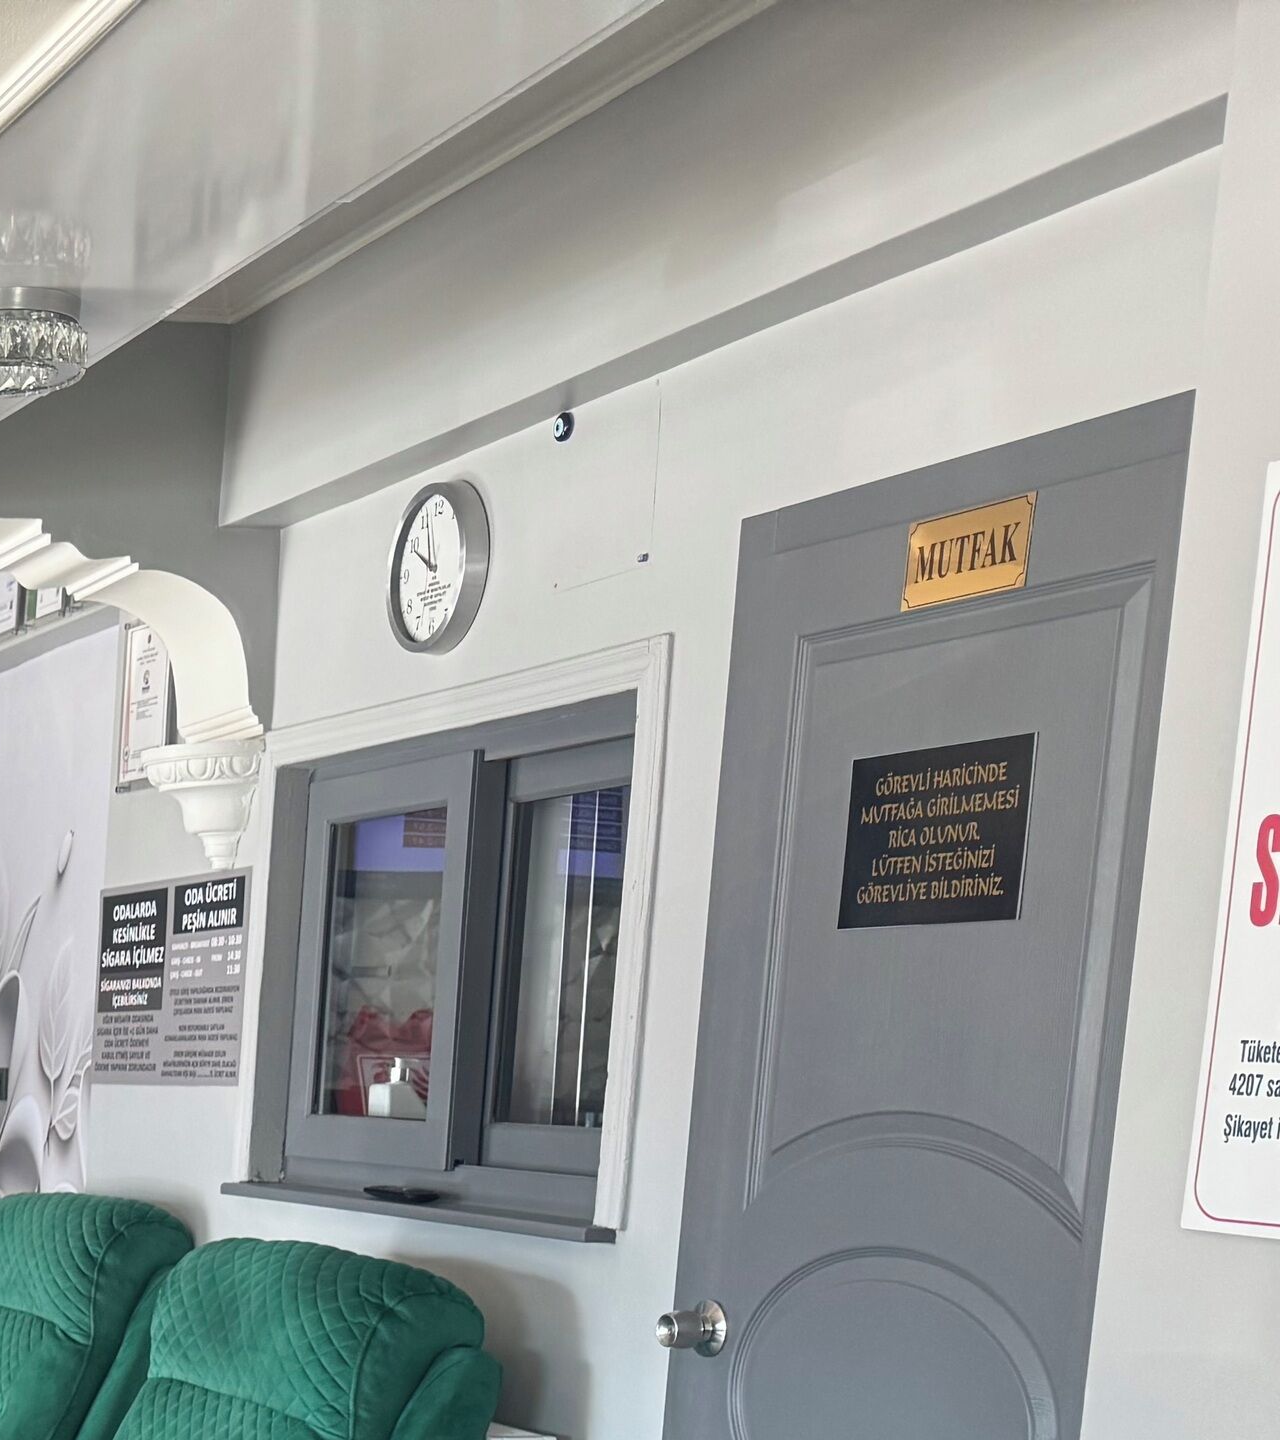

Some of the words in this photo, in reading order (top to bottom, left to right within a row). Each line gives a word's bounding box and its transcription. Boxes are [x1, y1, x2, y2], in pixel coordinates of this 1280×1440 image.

[434, 500, 445, 517] 12
[410, 537, 420, 554] 10
[914, 521, 1022, 585] MUTFAK
[402, 569, 410, 584] 9
[406, 600, 413, 614] 8
[415, 616, 421, 631] 7
[875, 768, 931, 796] GÖREVLİ
[933, 761, 1008, 789] HARİCİNDE
[860, 797, 923, 825] MUTFAĞA
[927, 784, 1020, 818] GİRİLMEMESİ
[888, 825, 917, 849] RİCA
[920, 821, 980, 846] OLUNUR.
[871, 854, 922, 877] LÜTFEN
[924, 843, 996, 873] İSTEĞİNİZİ
[184, 887, 204, 906] ODA
[205, 878, 237, 904] ÜCRETİ
[856, 877, 928, 904] GÖREVLİYE
[930, 872, 1004, 900] BİLDİRİNİZ.
[113, 900, 157, 922] ODALARDA
[181, 908, 207, 934] PEŞİN
[207, 907, 237, 928] ALINIR
[112, 922, 156, 944] KESİNLİKLE
[101, 948, 131, 968] SİGARA
[132, 945, 165, 968] İÇİLMEZ
[131, 976, 162, 990] BALKONDA
[1229, 1073, 1264, 1096] 4207
[1223, 1113, 1274, 1144] Şikayet
